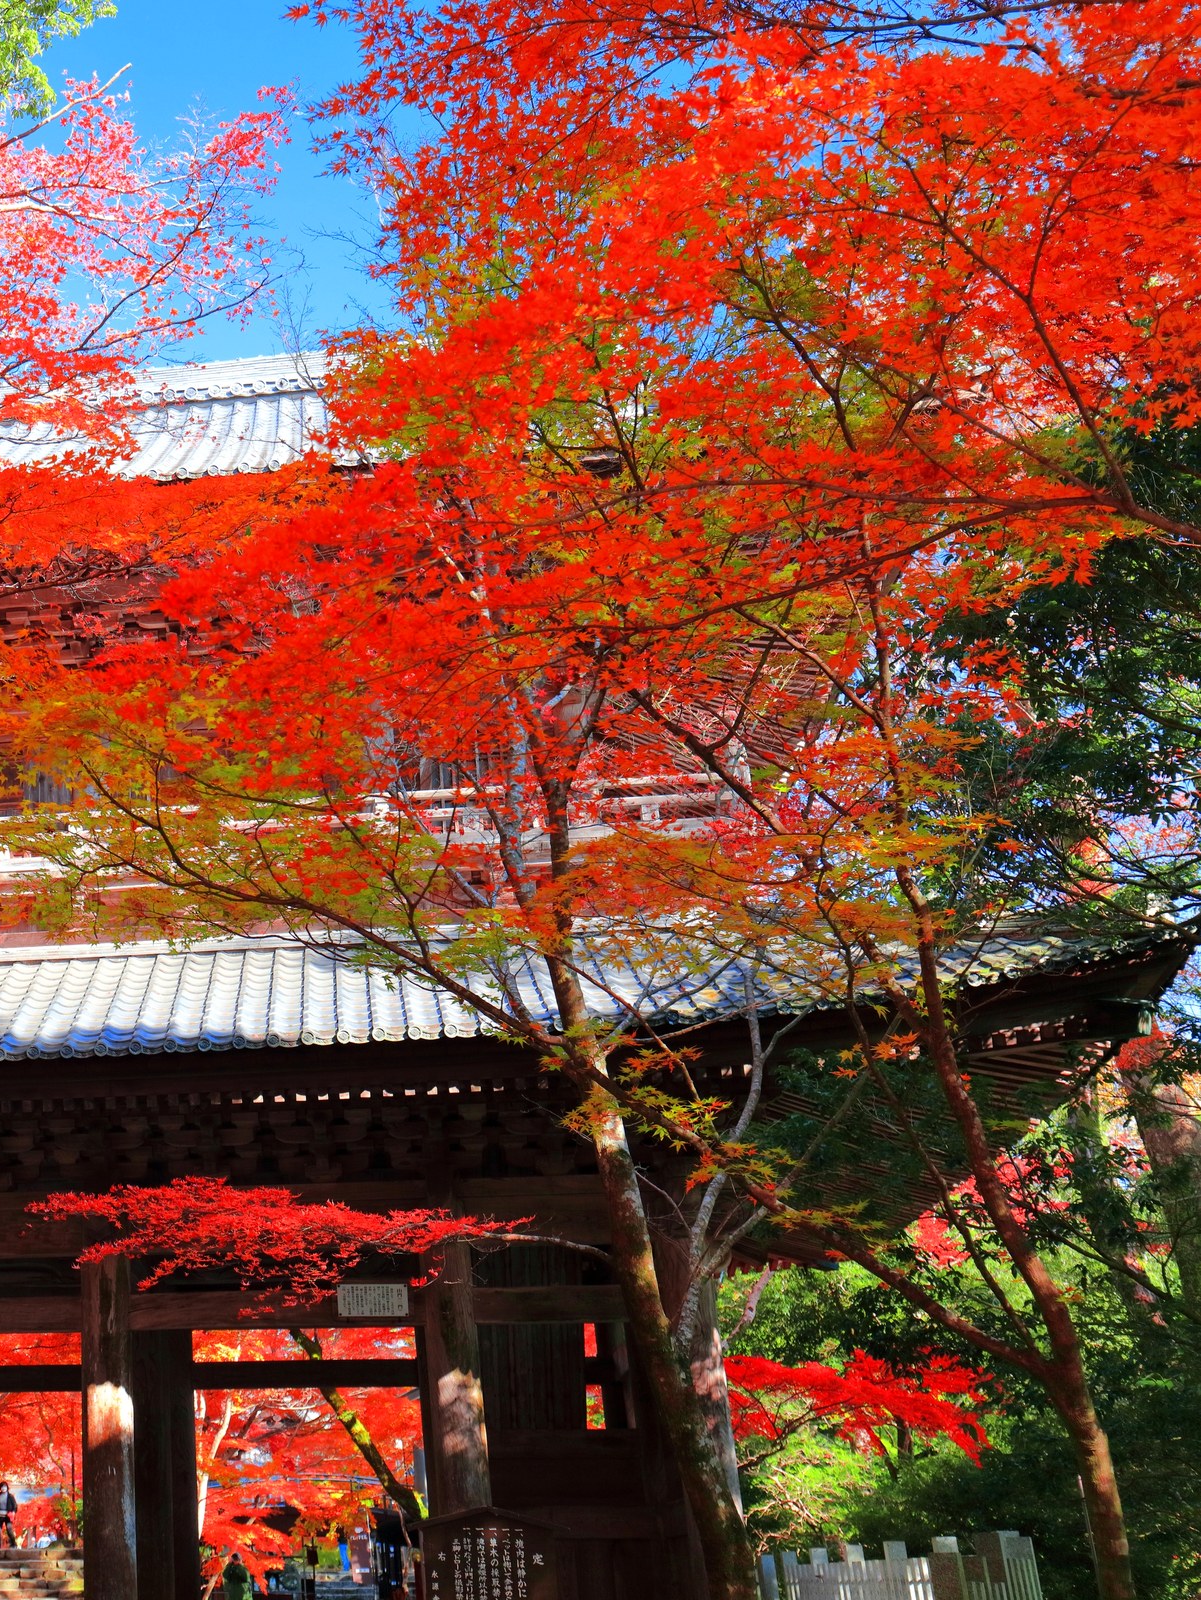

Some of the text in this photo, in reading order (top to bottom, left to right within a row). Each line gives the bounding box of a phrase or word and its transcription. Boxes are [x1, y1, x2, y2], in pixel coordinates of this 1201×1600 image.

[438, 1551, 446, 1562] 右
[532, 1553, 544, 1565] 定
[489, 1527, 501, 1600] 一、草木の採取禁
